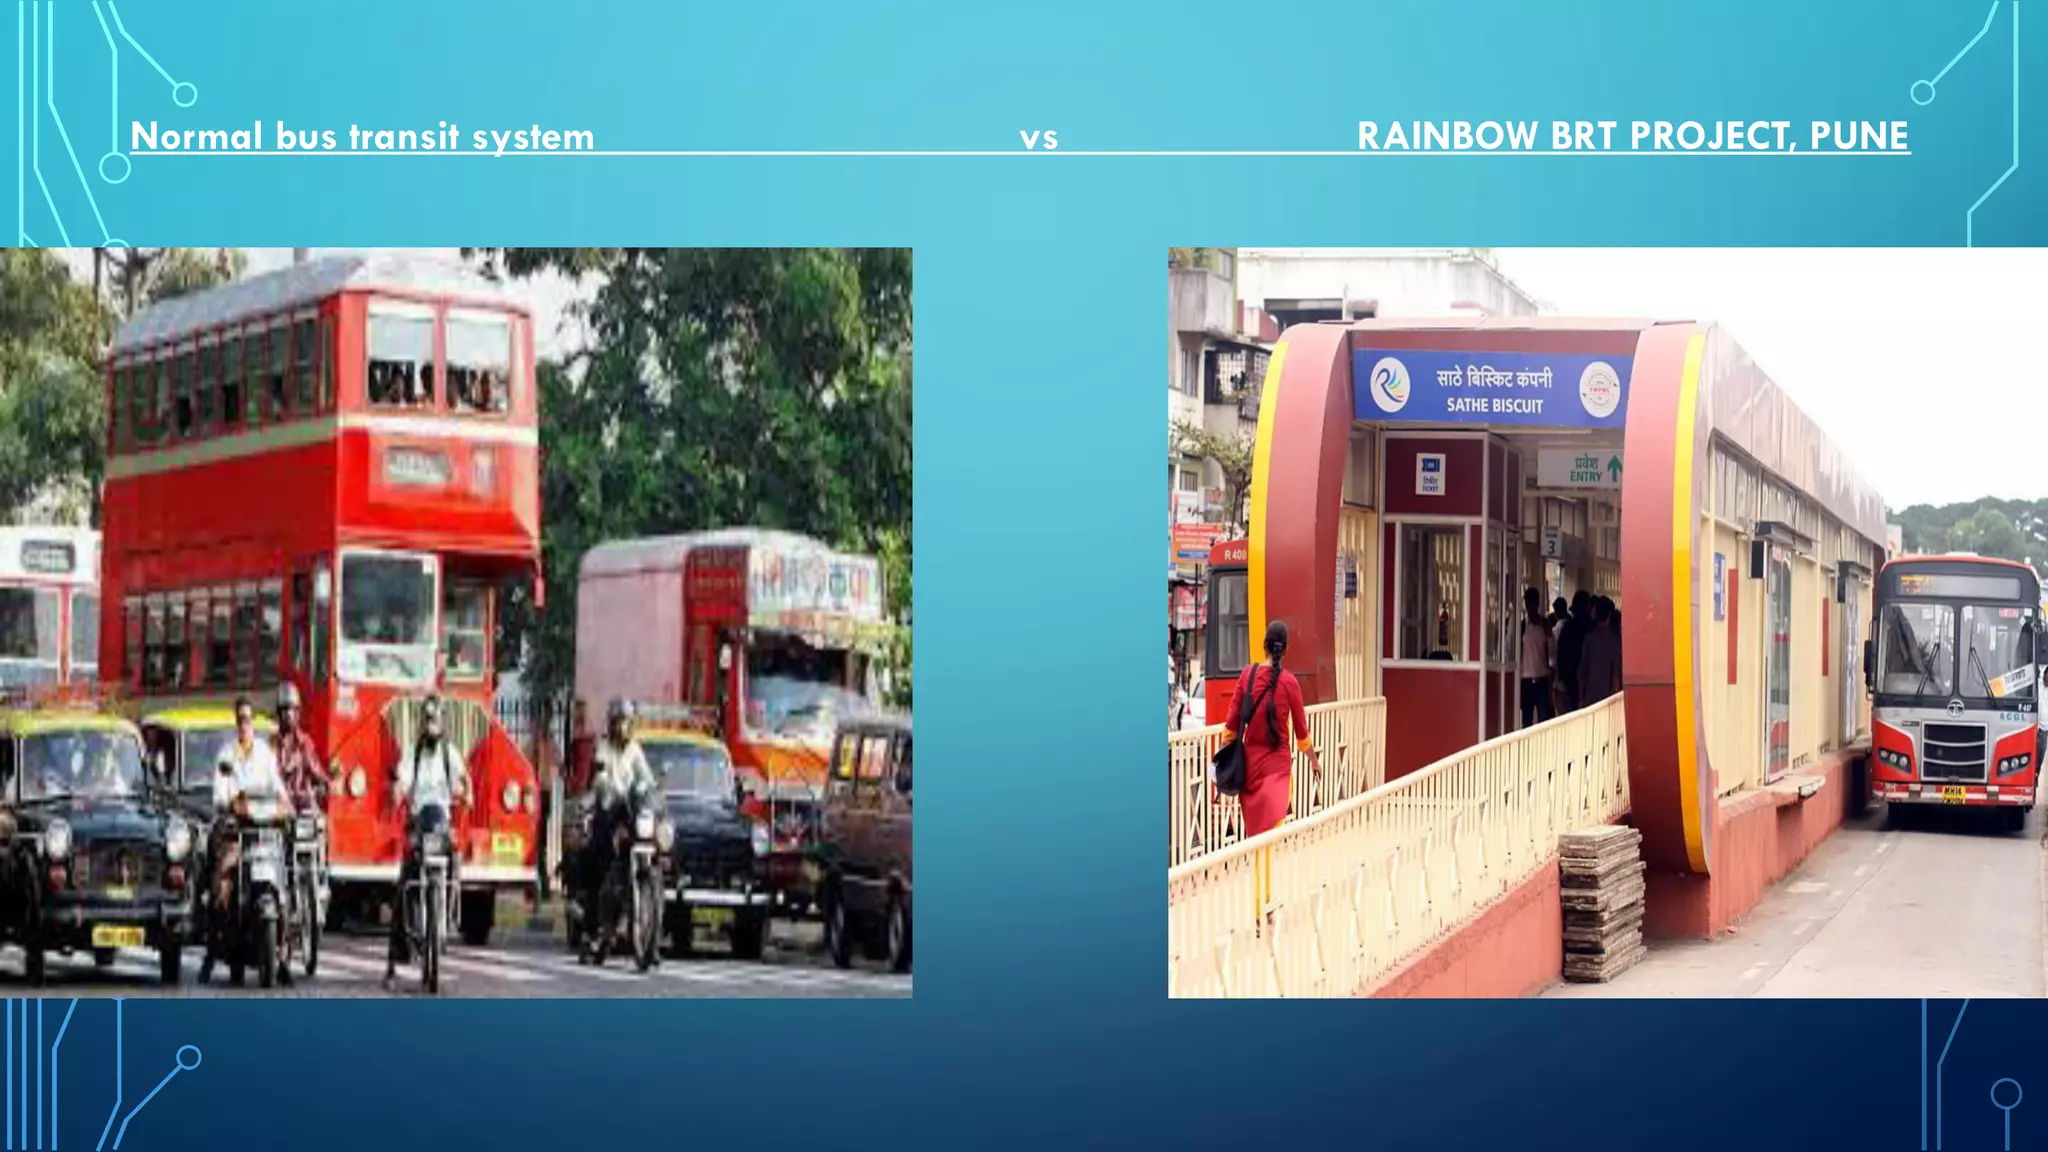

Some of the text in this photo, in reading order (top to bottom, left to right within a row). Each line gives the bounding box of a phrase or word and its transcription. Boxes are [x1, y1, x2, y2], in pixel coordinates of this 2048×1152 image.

[1437, 365, 1552, 388] साठे बिस्किट कंपनी
[1447, 398, 1543, 414] SATHE BISCUIT
[1570, 471, 1602, 482] ENTRY
[1224, 549, 1232, 560] R
[1547, 540, 1555, 555] 3
